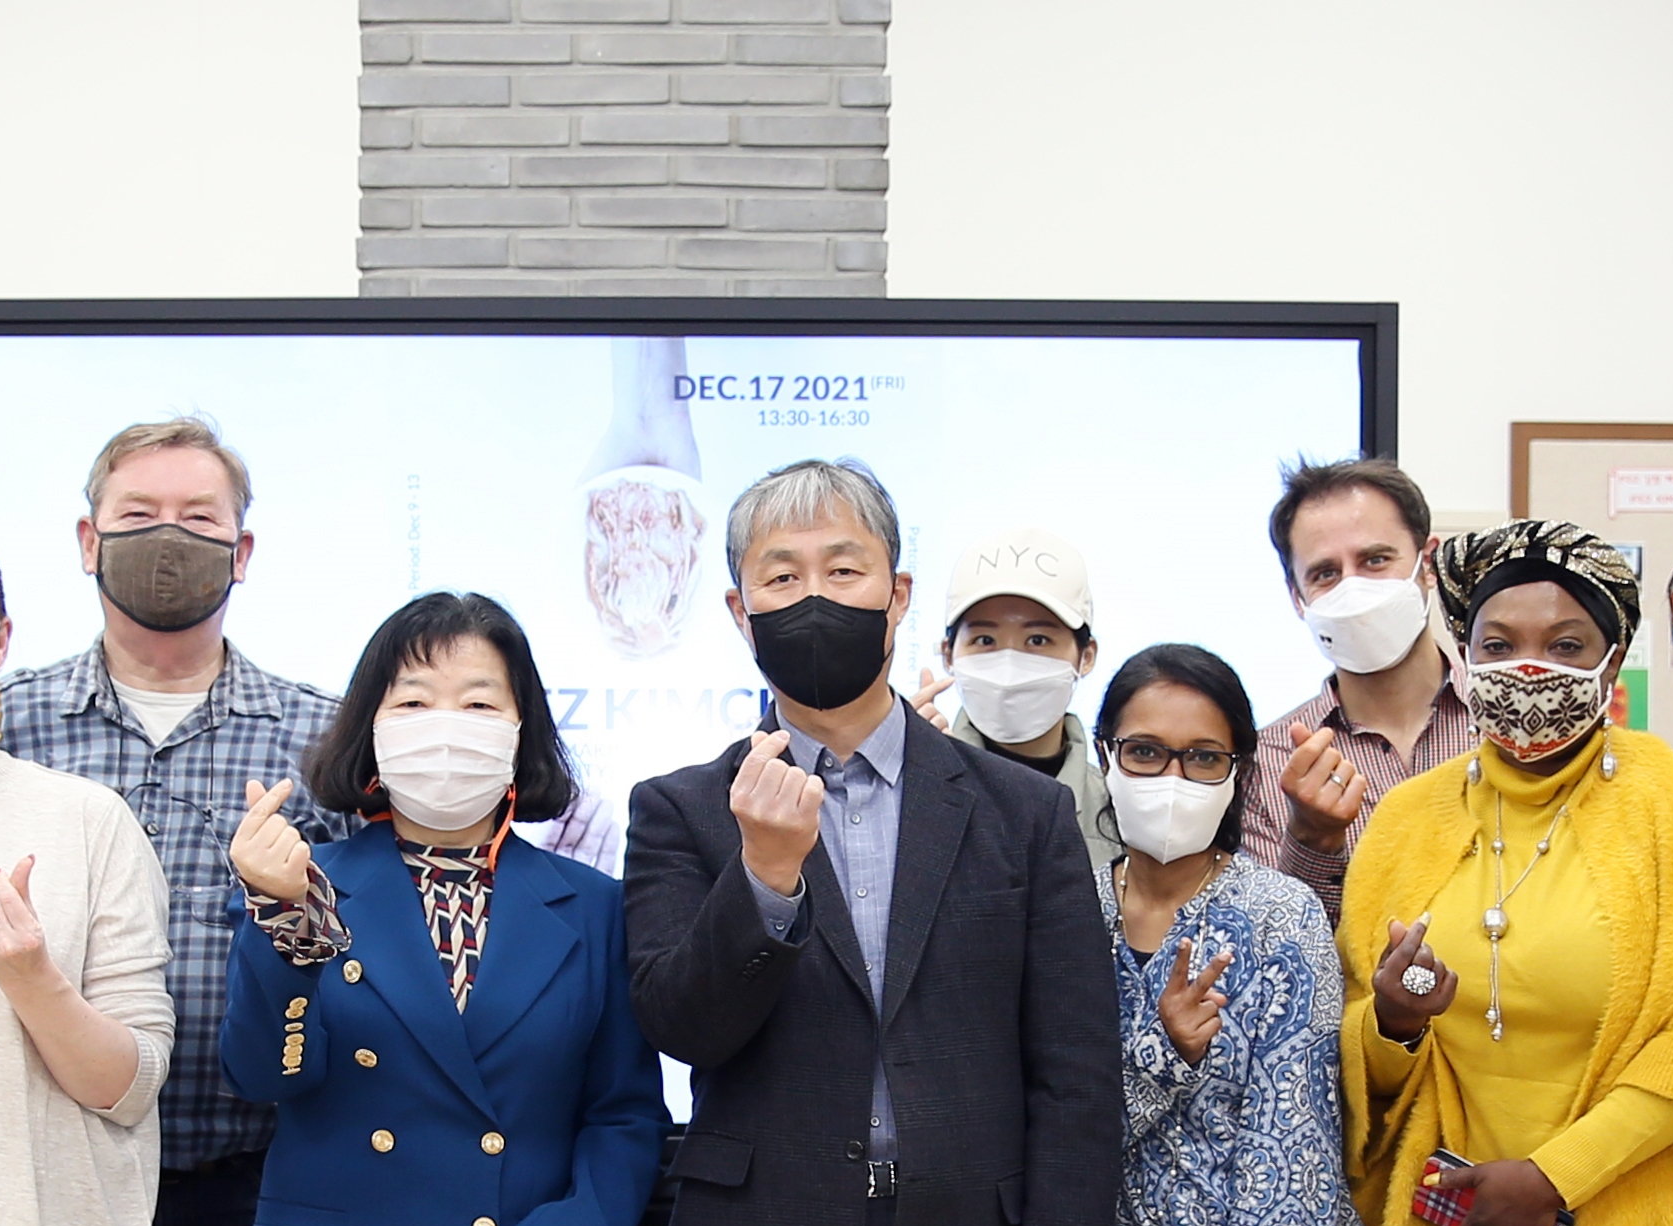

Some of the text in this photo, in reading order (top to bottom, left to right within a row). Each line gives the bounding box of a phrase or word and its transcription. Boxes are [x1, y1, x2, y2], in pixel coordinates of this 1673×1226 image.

[673, 375, 906, 400] DEC.17 2021 (FRI)
[758, 409, 871, 427] 13:30-16:30
[407, 515, 421, 541] Dec
[975, 544, 1060, 578] NYC
